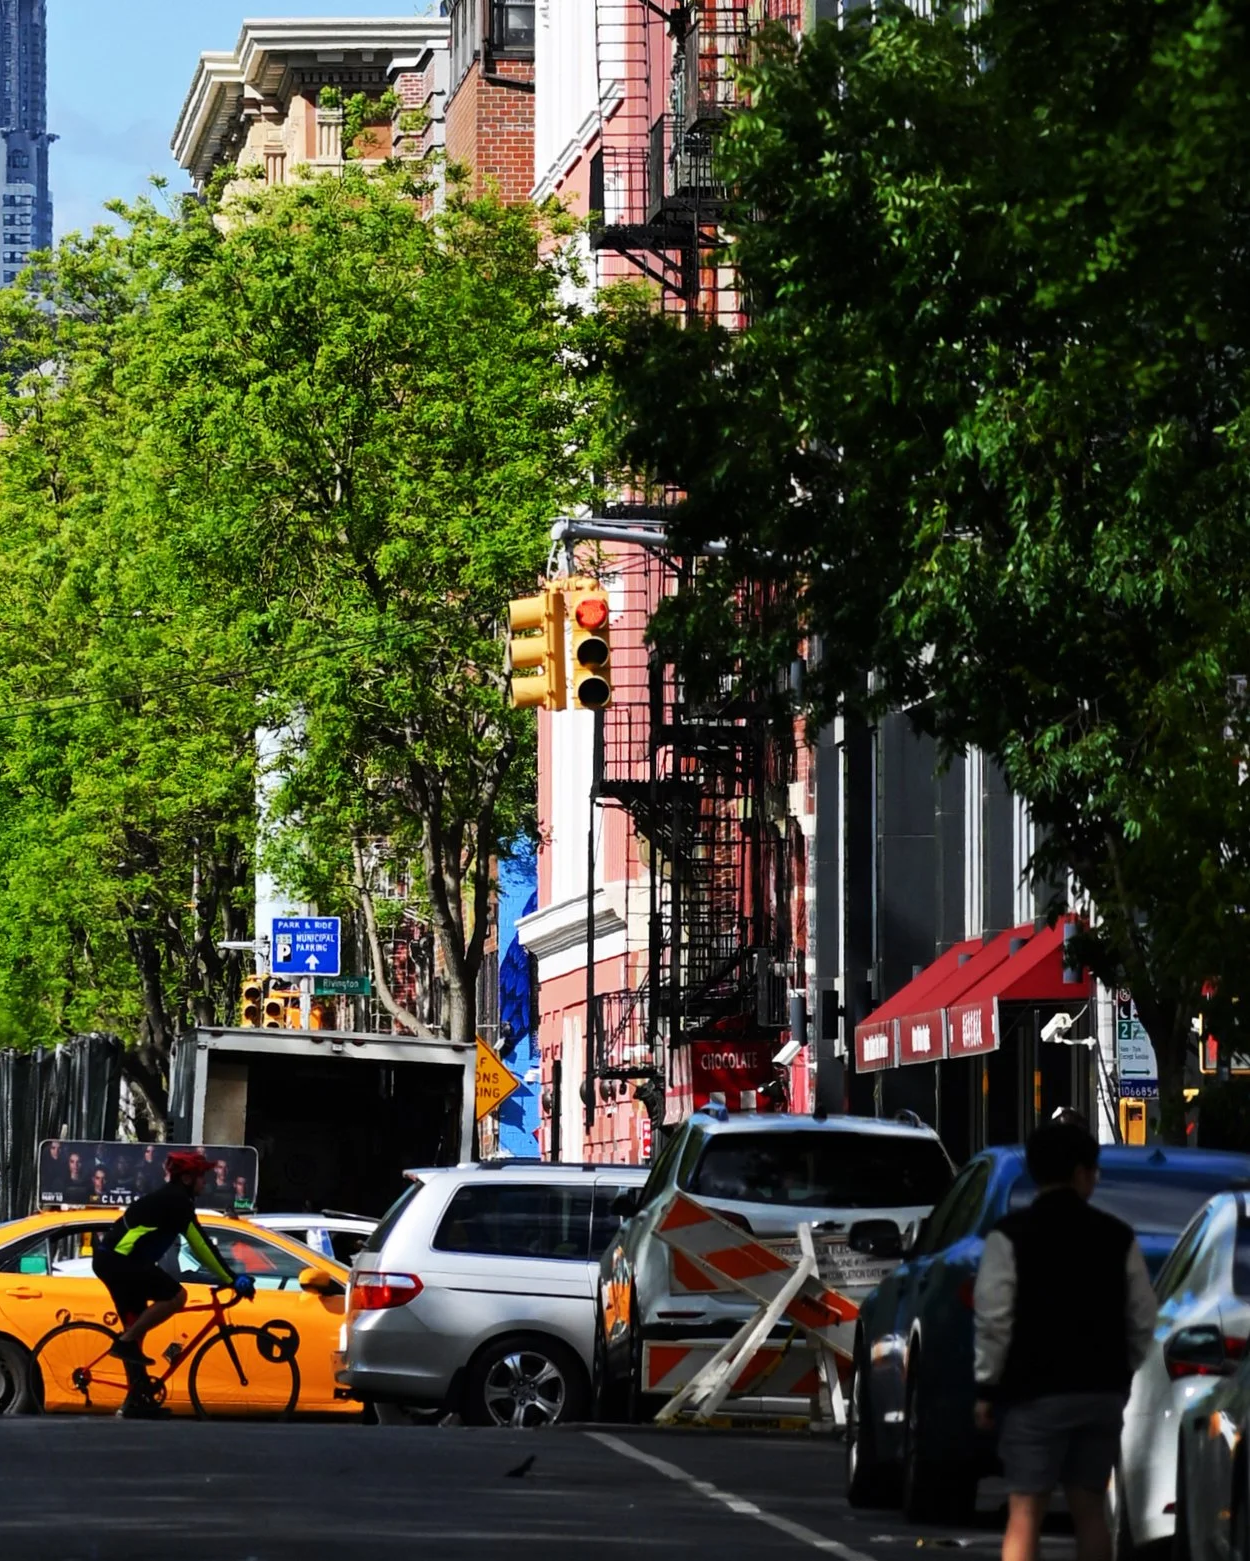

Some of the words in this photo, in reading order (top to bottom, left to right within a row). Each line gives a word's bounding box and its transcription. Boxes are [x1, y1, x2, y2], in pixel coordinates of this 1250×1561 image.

[277, 921, 300, 929] PARK
[304, 921, 310, 929] &
[314, 921, 333, 929] RIDE
[296, 934, 335, 943] MUNICIPAL
[296, 944, 328, 952] PARKING
[322, 978, 359, 991] Rivington
[1121, 1023, 1129, 1039] 2
[701, 1052, 758, 1070] CHOCOLATE
[1121, 1086, 1153, 1097] 106685
